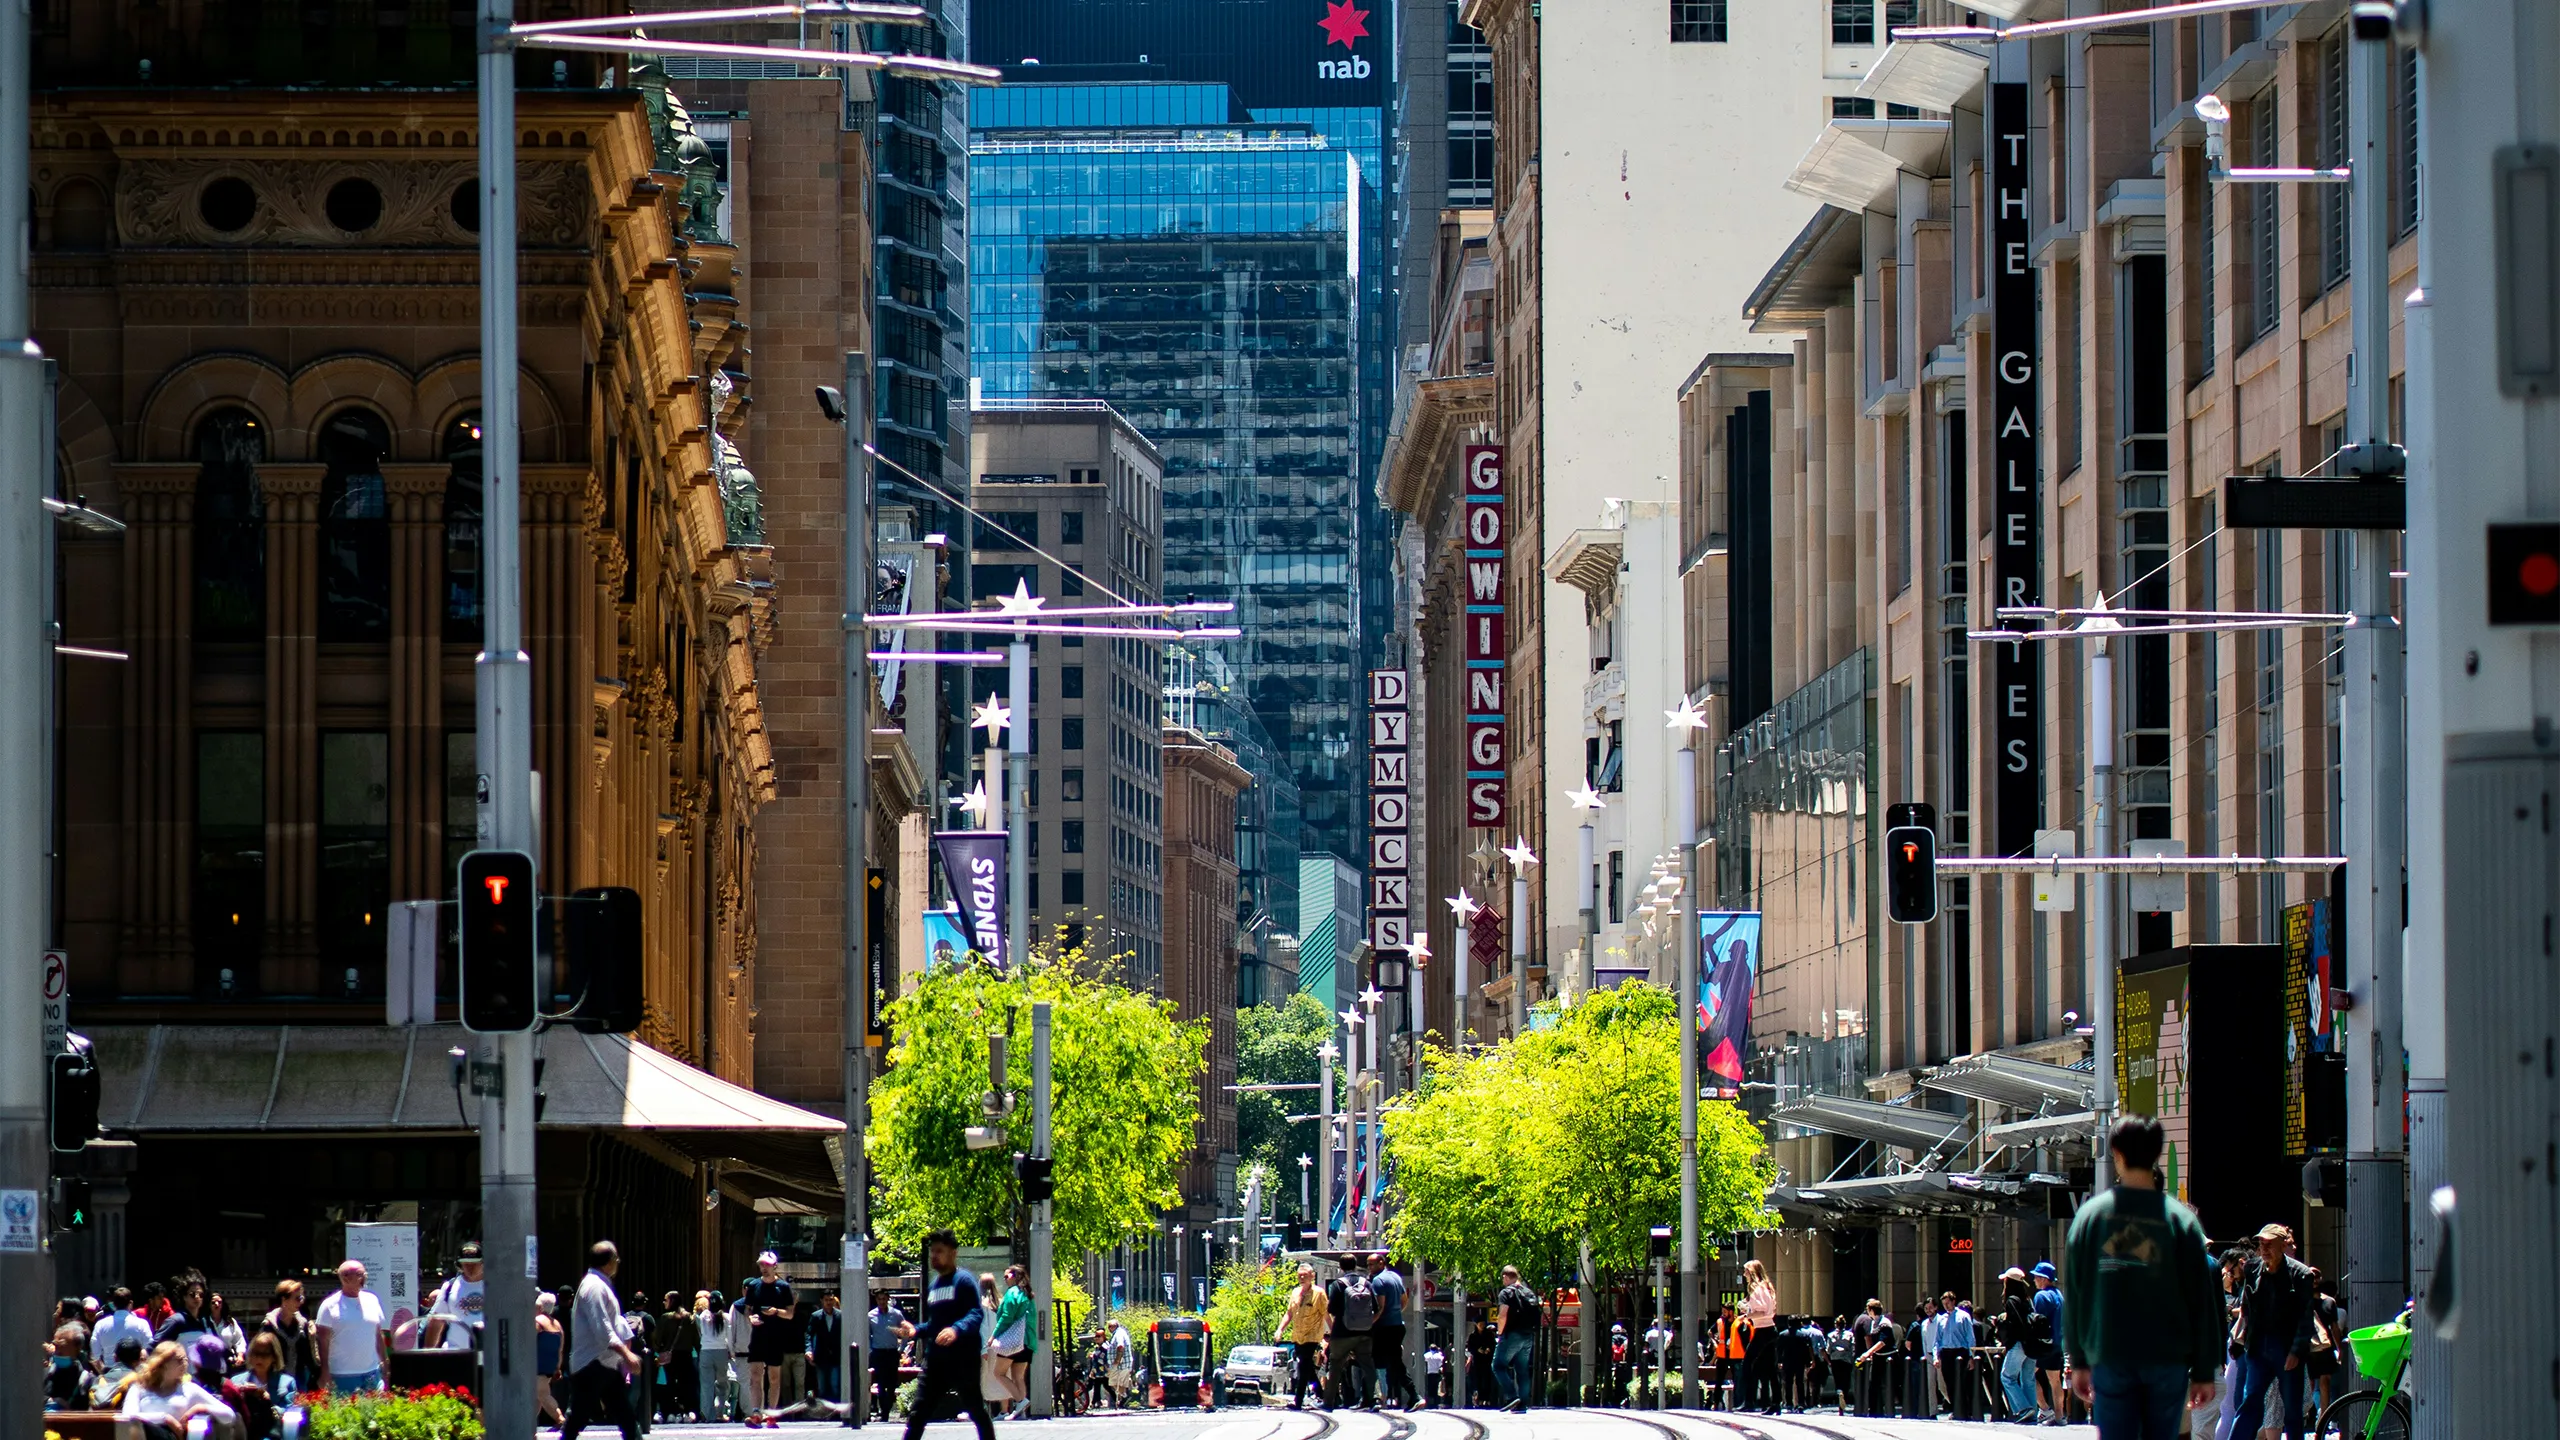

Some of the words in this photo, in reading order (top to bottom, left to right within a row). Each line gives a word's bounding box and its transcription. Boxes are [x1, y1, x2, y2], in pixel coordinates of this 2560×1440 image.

[1318, 54, 1371, 79] nab
[2001, 134, 2028, 274] THE
[1469, 450, 1501, 821] GOWINGS
[1376, 675, 1404, 946] DYMOCKS
[971, 857, 1000, 968] SYDNEY
[43, 1003, 61, 1020] NO
[43, 1024, 65, 1035] IGHT
[45, 1040, 63, 1051] URN
